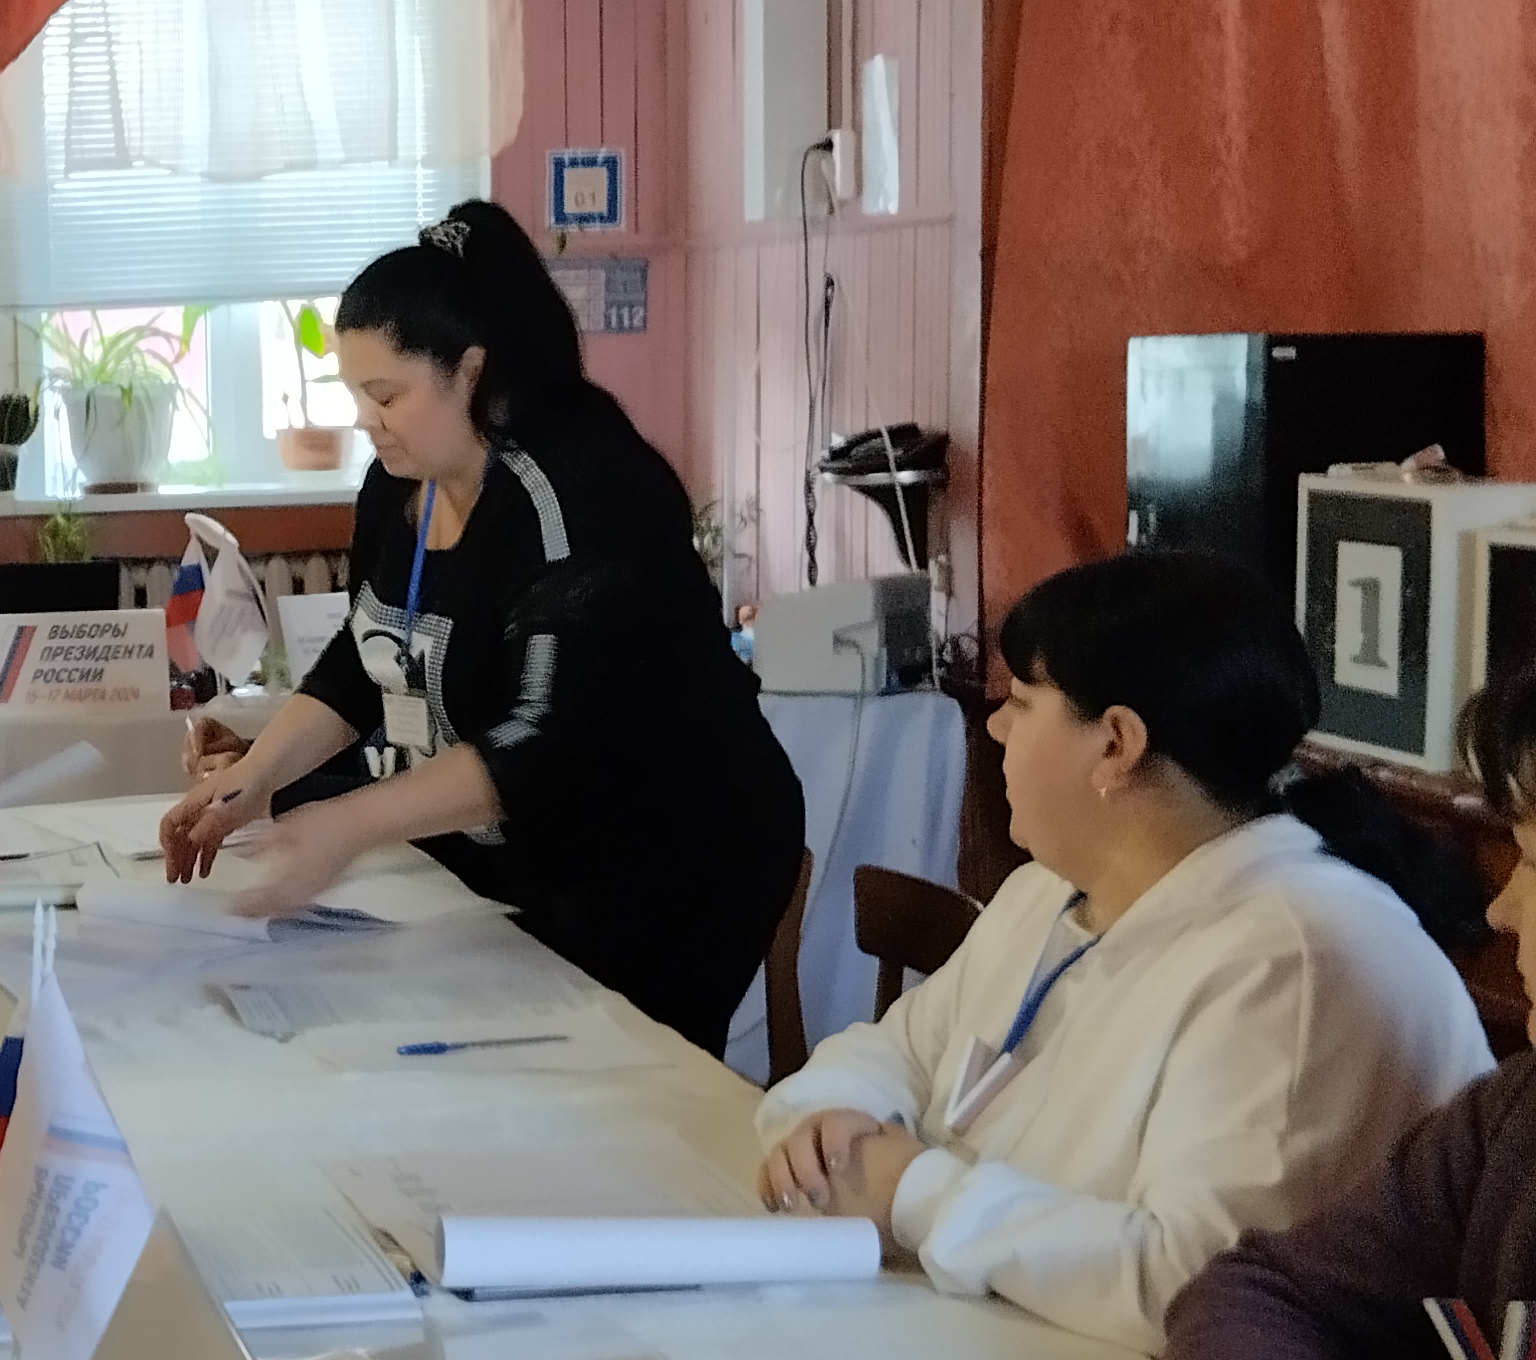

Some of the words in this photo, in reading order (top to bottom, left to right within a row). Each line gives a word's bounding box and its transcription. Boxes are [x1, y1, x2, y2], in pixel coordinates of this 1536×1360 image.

[573, 190, 597, 208] 01
[608, 305, 645, 328] 112
[46, 622, 129, 640] ВЫБОРЫ
[1347, 576, 1390, 669] 1
[38, 643, 155, 662] ПРЕЗИДЕНТА
[30, 667, 105, 684] РОССИИ
